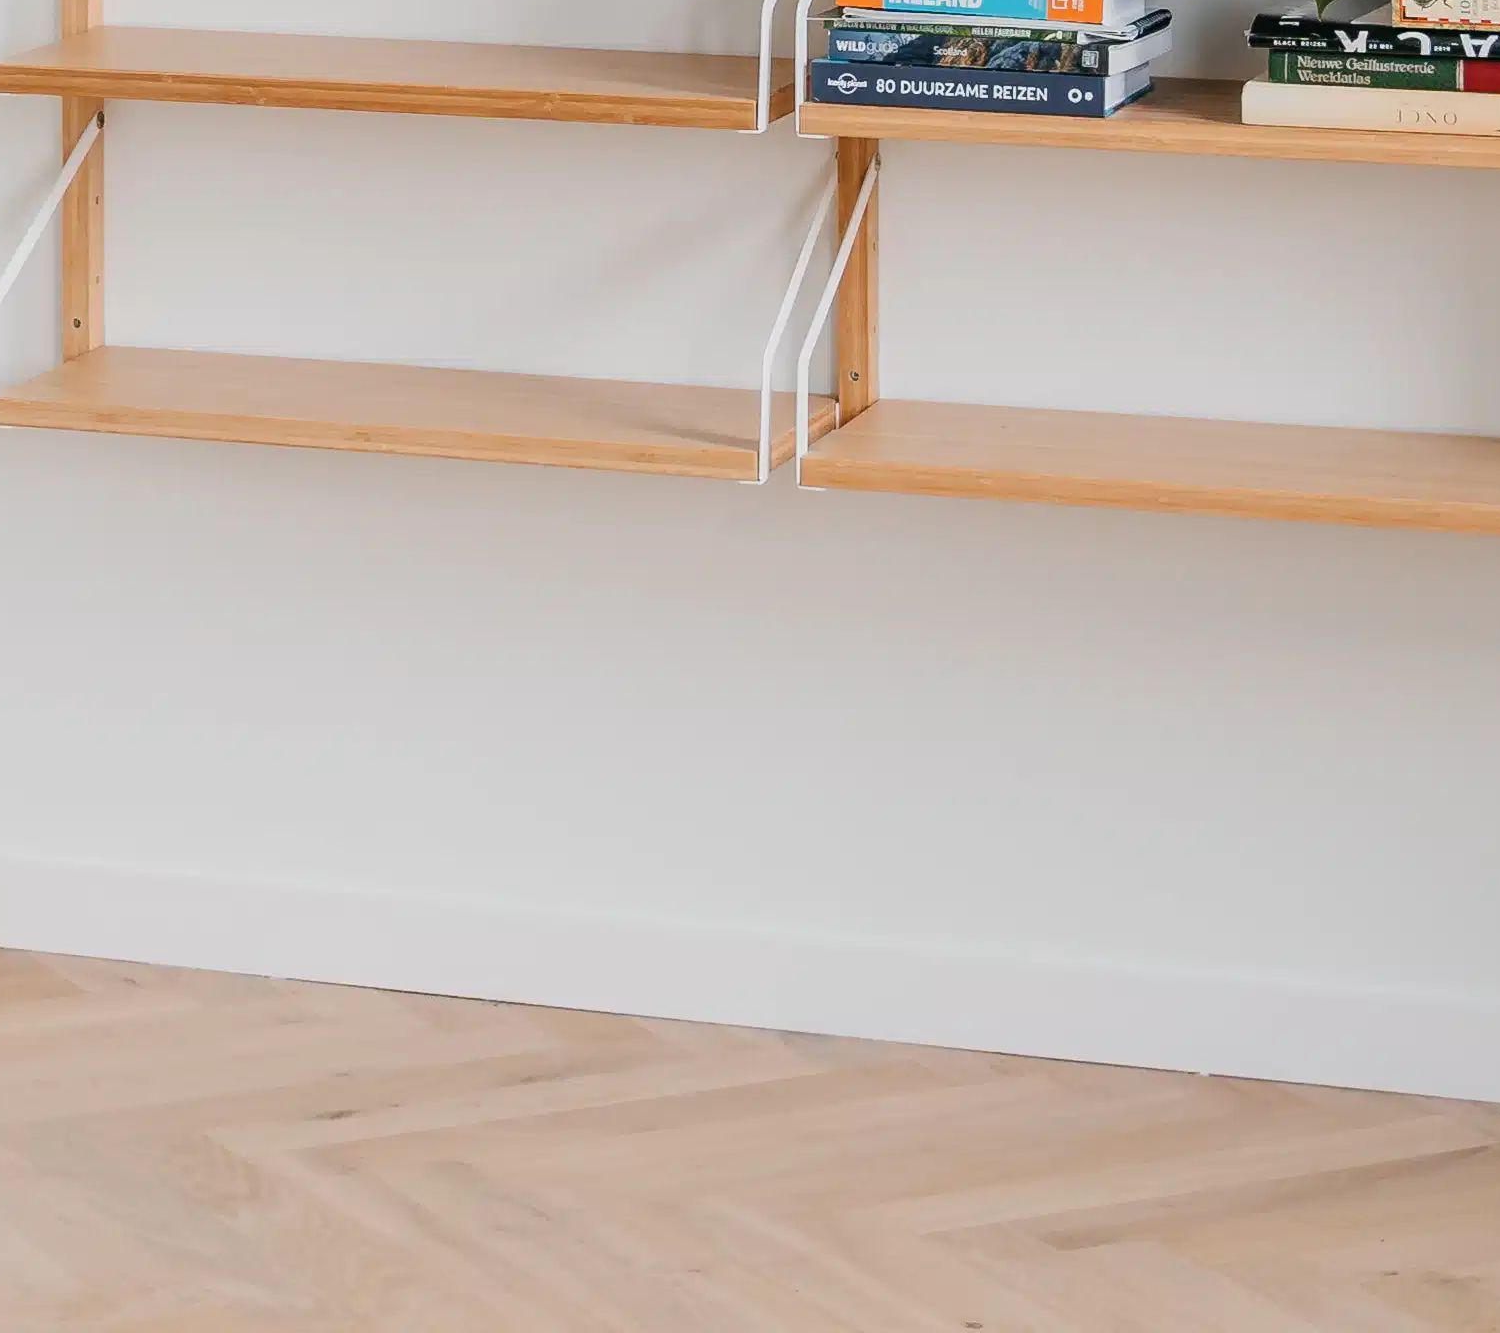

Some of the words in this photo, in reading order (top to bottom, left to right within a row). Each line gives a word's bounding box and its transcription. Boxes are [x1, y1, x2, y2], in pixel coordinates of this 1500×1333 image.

[933, 46, 968, 57] Scotland
[1297, 56, 1343, 69] Nieuwe
[1297, 69, 1371, 85] Wereldatlas
[876, 79, 896, 93] 80
[900, 80, 989, 100] DUURZAME
[993, 83, 1048, 102] REIZEN
